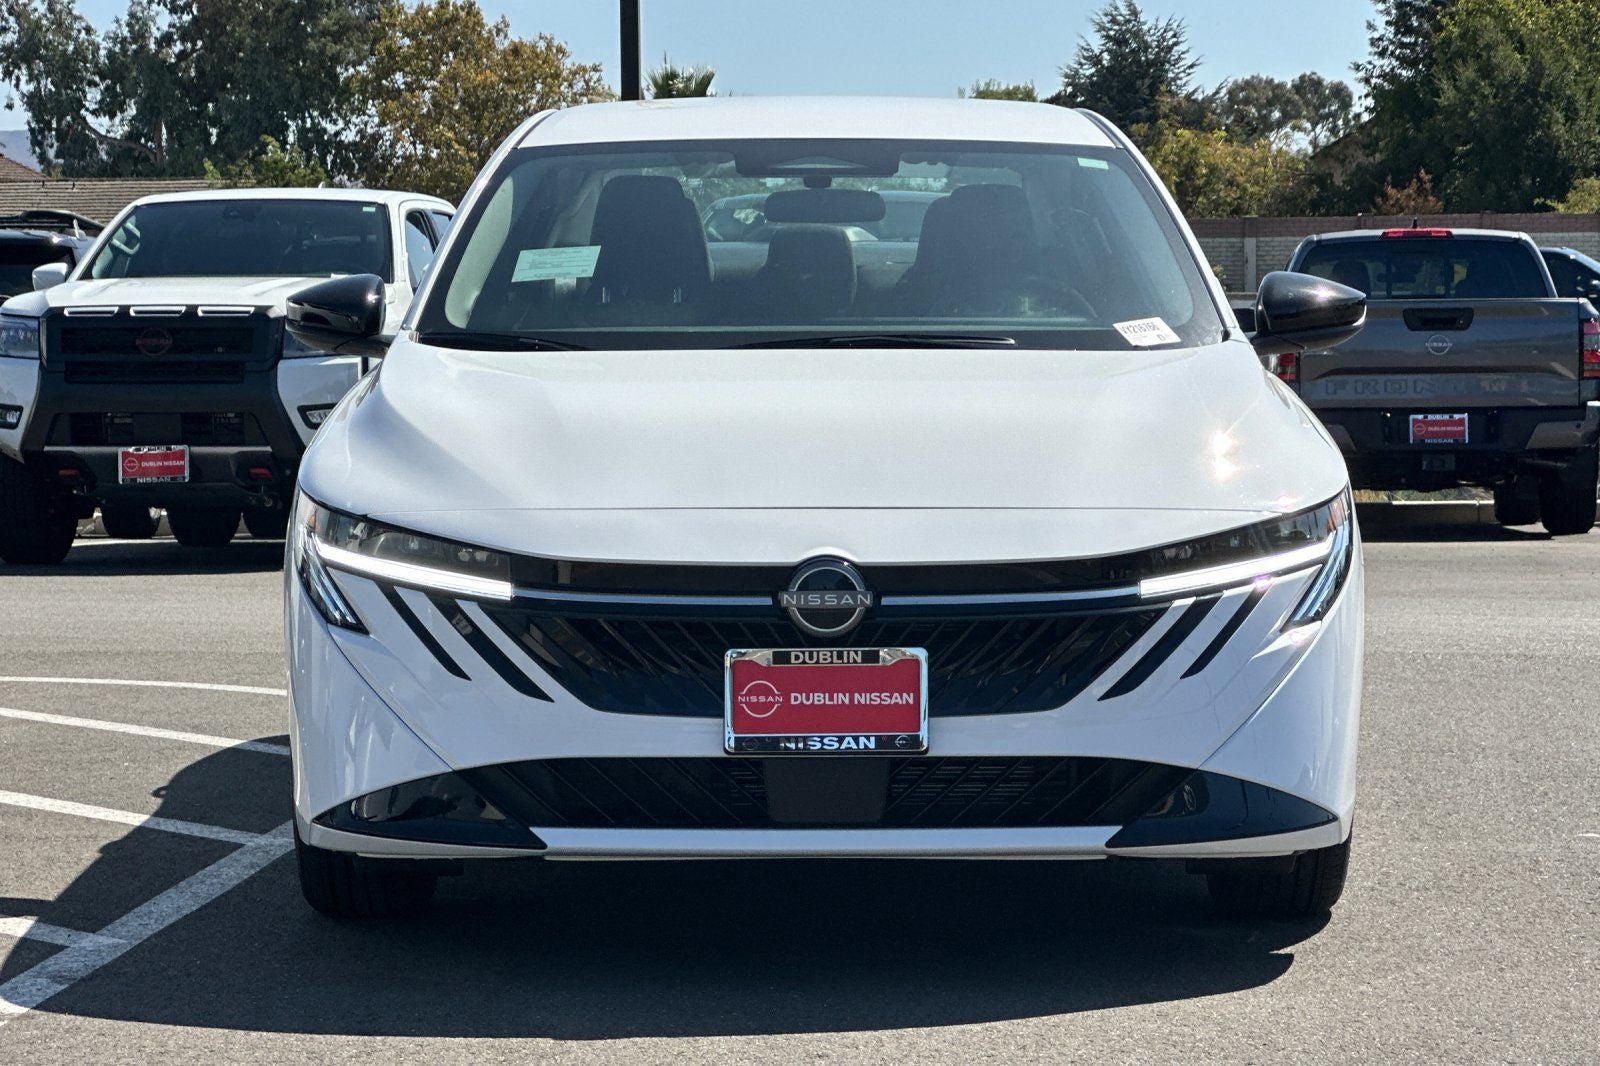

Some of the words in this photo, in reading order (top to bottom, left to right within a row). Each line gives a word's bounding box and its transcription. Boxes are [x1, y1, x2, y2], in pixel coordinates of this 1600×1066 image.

[783, 593, 871, 605] NISSAN
[790, 650, 862, 664] DUBLIN
[790, 693, 850, 705] DUBLIN
[854, 692, 914, 705] NISSAN
[779, 736, 876, 751] NISSAN
